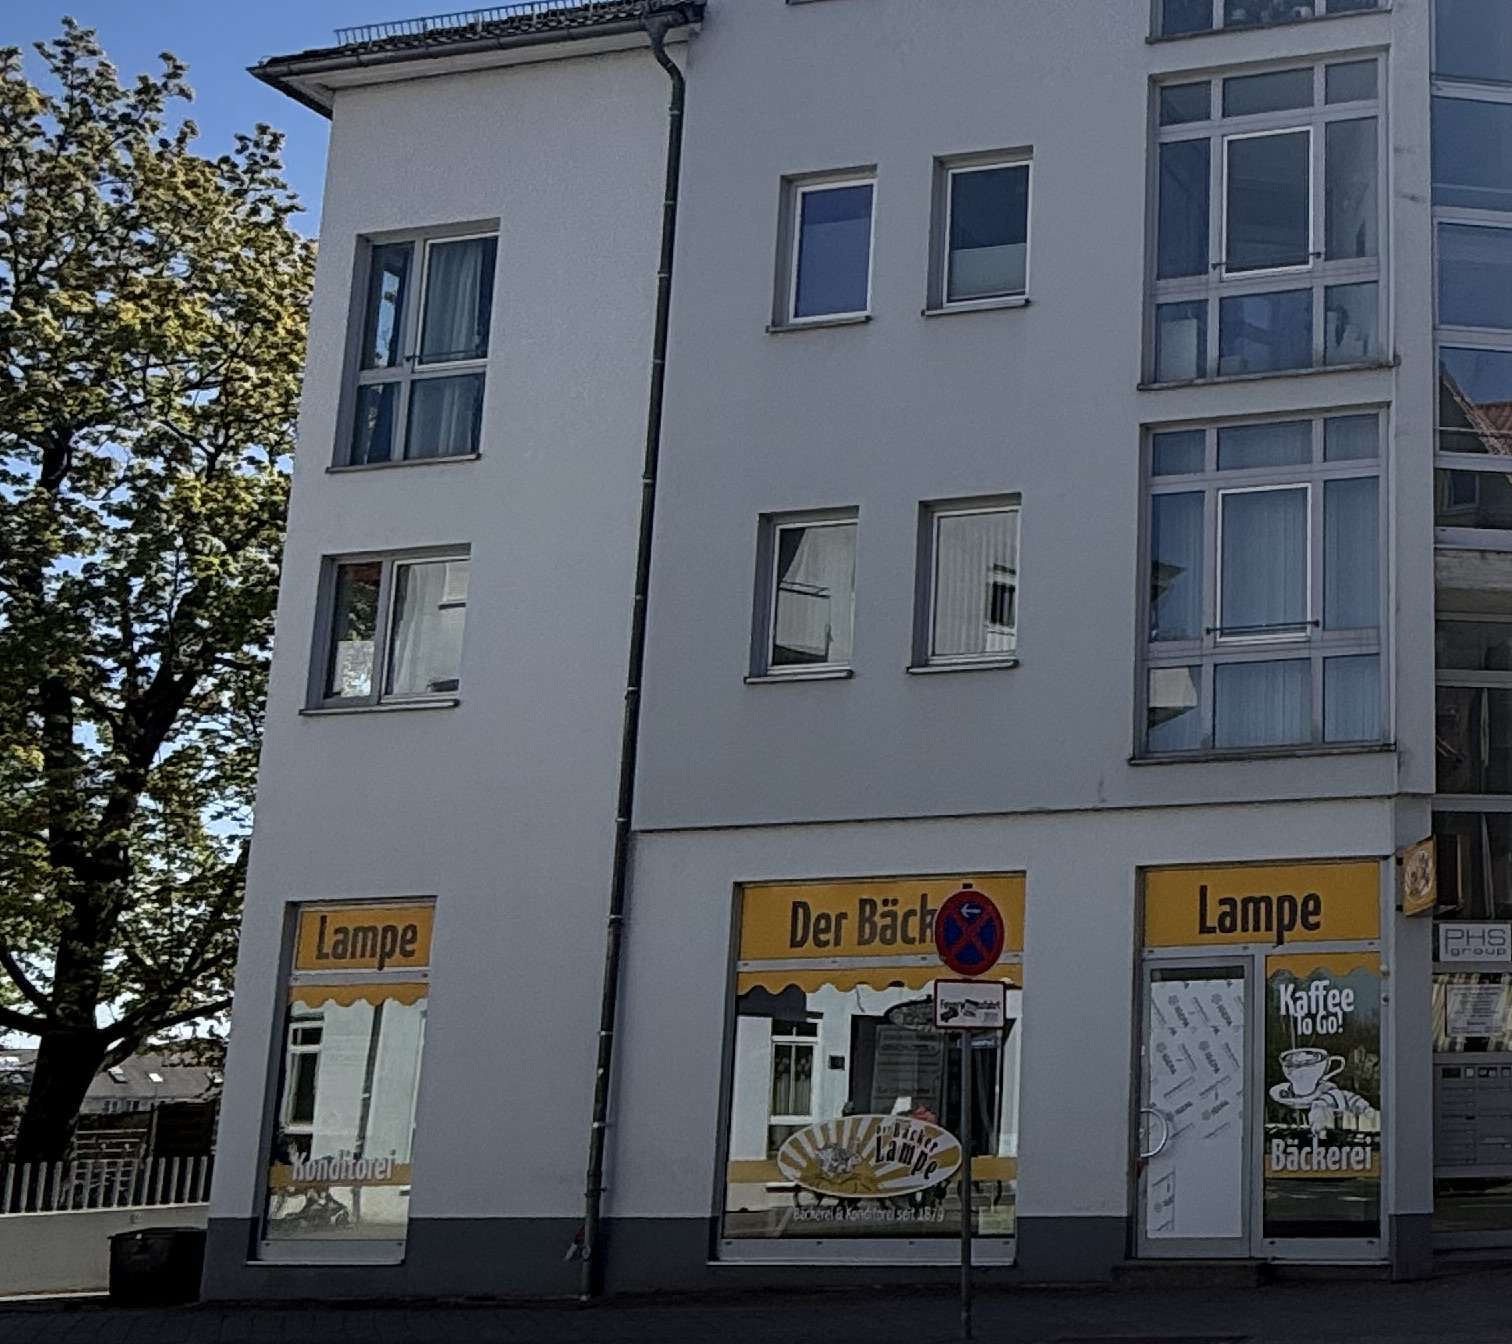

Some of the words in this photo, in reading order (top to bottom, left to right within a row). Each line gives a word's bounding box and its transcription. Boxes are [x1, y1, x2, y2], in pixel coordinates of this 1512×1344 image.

[790, 900, 848, 948] Der
[857, 892, 938, 946] Bäck
[1198, 885, 1322, 945] Lampe
[315, 914, 419, 971] Lampe
[1445, 928, 1506, 954] PHS
[1451, 947, 1507, 957] group
[1279, 979, 1354, 1016] Kaffee
[1295, 1012, 1314, 1035] To
[1316, 1010, 1344, 1035] Go!
[290, 1149, 396, 1183] Konditorei
[875, 1135, 938, 1180] Lampe
[1271, 1133, 1373, 1171] Bäckerei
